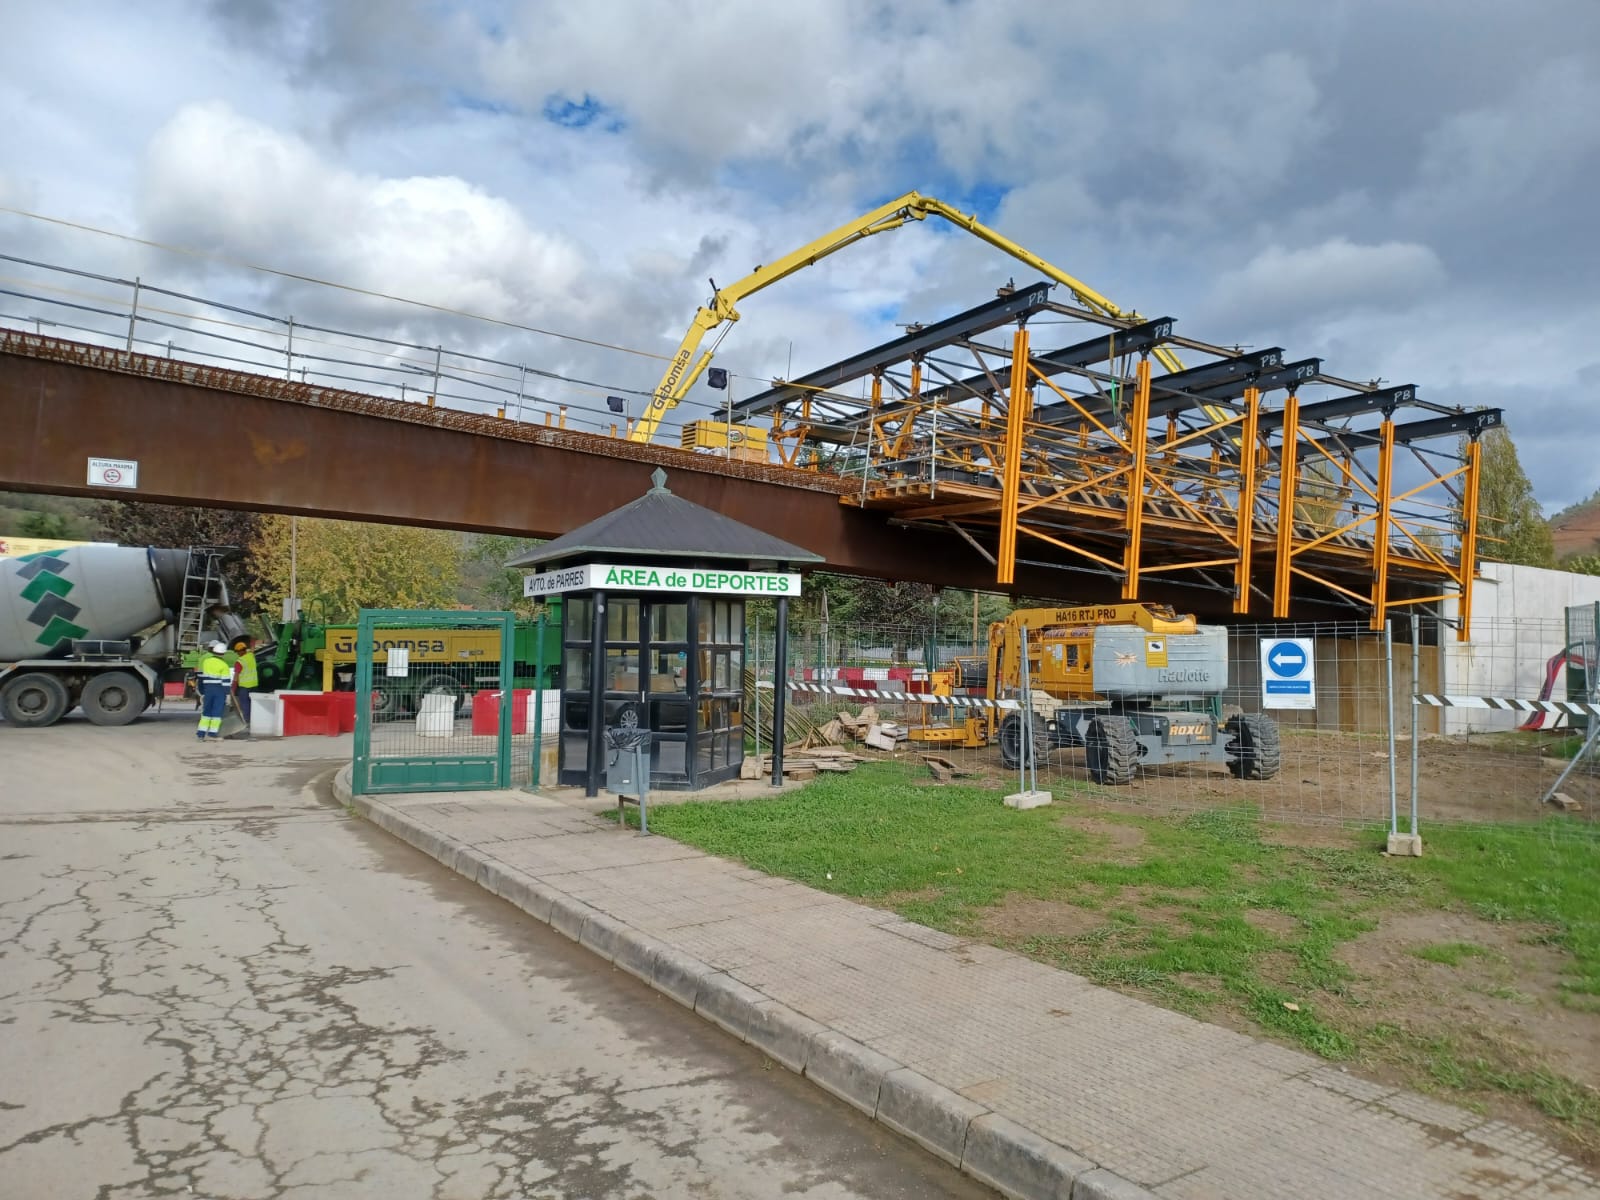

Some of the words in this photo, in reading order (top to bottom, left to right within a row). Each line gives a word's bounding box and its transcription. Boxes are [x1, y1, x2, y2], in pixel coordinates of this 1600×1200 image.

[1028, 289, 1045, 306] PB
[1153, 322, 1170, 339] PB
[1261, 354, 1277, 367] PB
[652, 349, 690, 410] Gebomsa
[1296, 365, 1314, 379] PB
[1394, 389, 1411, 403] PB
[1477, 414, 1496, 427] PB
[528, 577, 546, 593] AYTO.
[547, 576, 555, 590] de
[555, 570, 585, 588] PARRES
[605, 566, 661, 587] ÁREA
[665, 572, 687, 588] de
[692, 572, 789, 592] DEPORTES
[1056, 611, 1077, 622] HA16
[1079, 609, 1095, 621] RTJ
[1097, 608, 1117, 620] PRO
[334, 636, 445, 654] Gomsa
[1158, 668, 1210, 683] Haulotte
